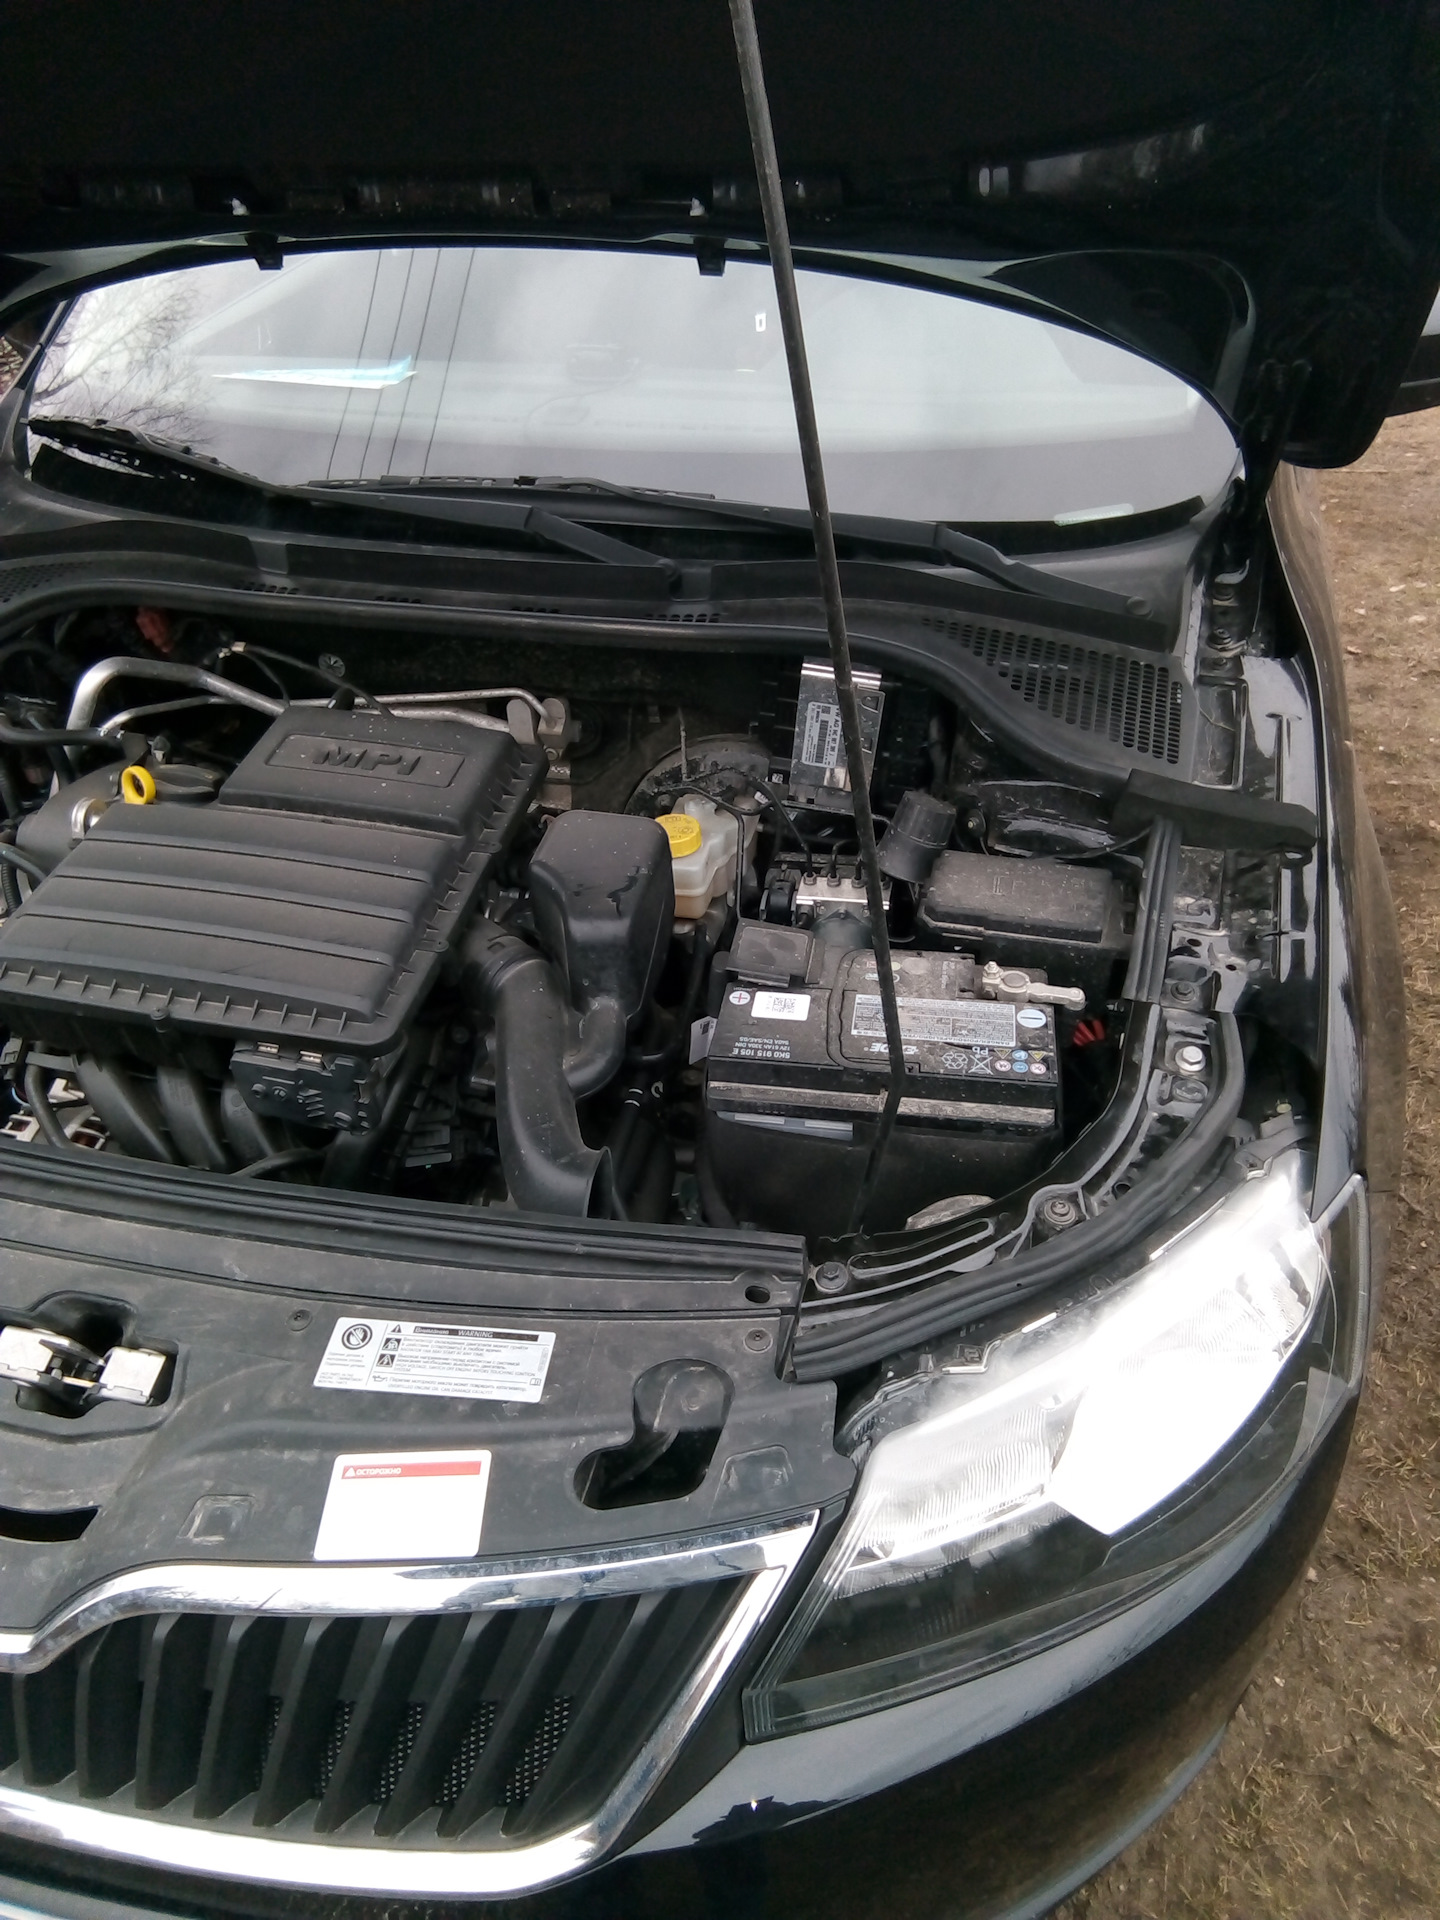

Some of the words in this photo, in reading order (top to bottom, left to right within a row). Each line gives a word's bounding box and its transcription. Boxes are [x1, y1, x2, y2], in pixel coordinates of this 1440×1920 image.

[312, 746, 422, 776] MPI
[972, 1046, 989, 1056] Pb
[458, 1330, 494, 1338] WARNING
[356, 1466, 402, 1476] ОСТОРОЖНО
